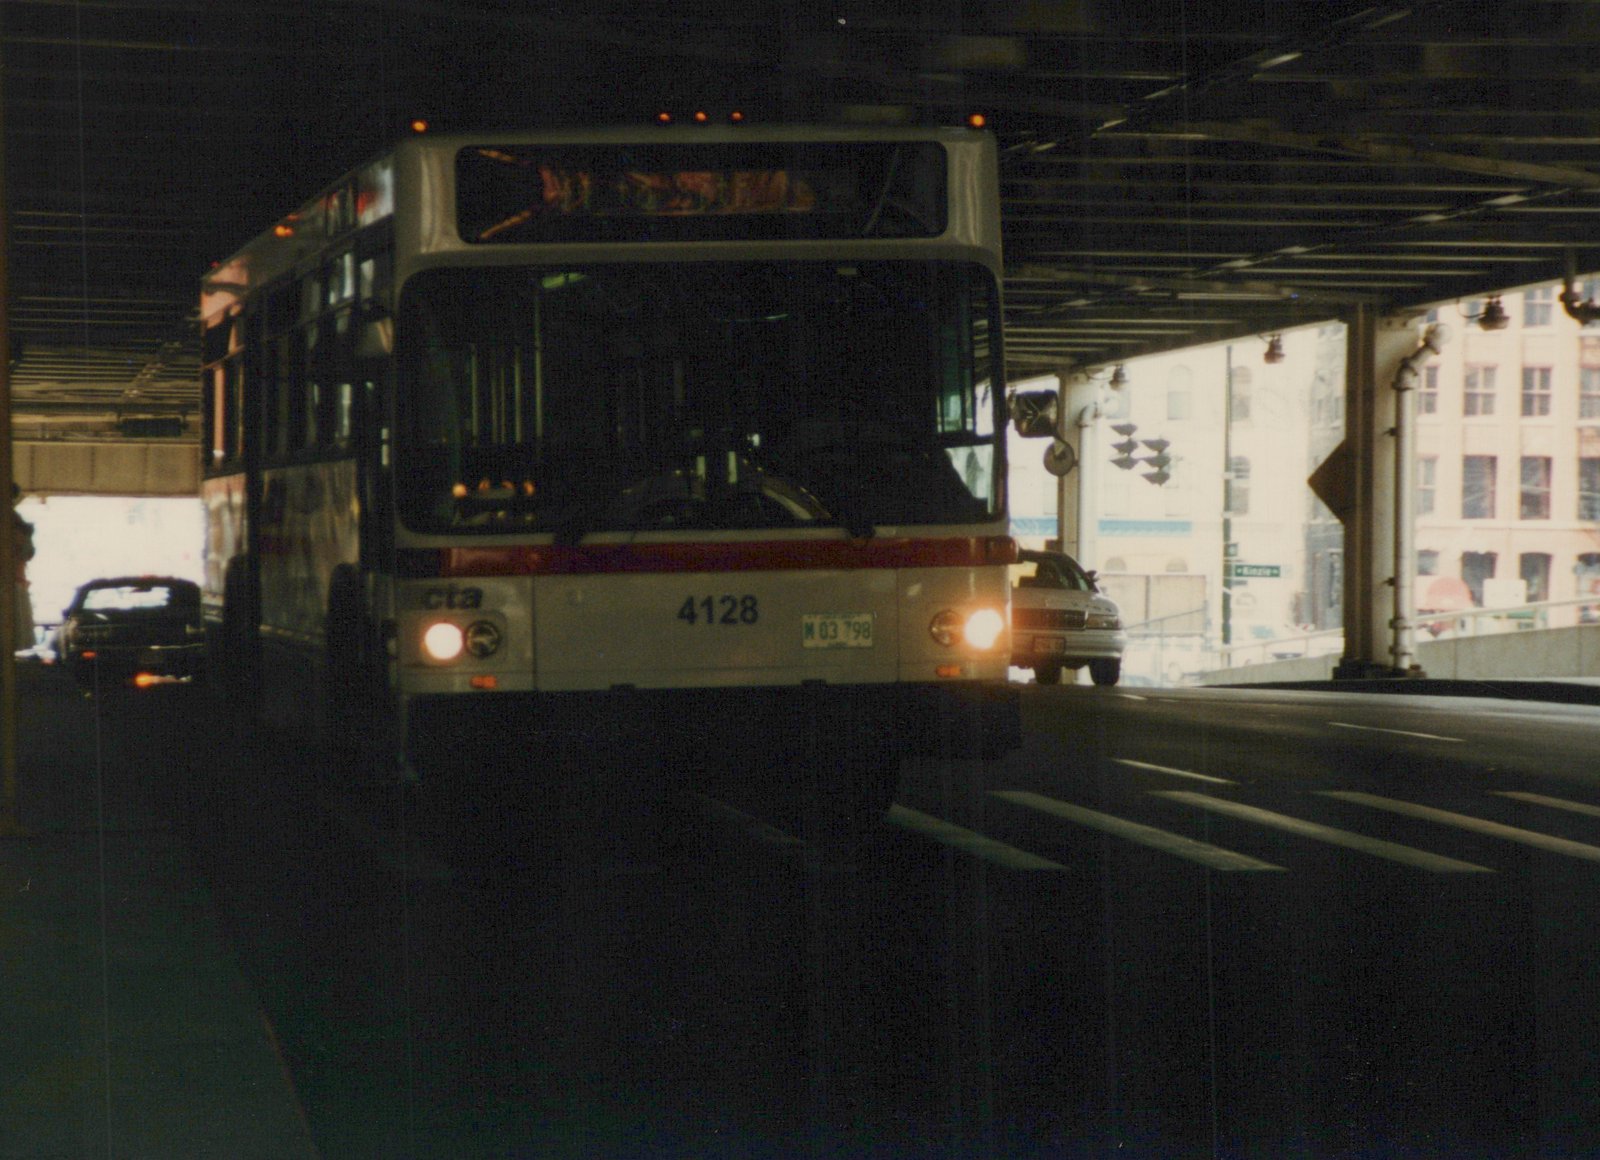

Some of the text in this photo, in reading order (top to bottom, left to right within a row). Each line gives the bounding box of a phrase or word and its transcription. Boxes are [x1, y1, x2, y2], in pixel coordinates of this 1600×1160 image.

[425, 584, 483, 609] cta
[678, 595, 759, 625] 4128
[819, 620, 838, 641] 03
[844, 620, 871, 641] 798
